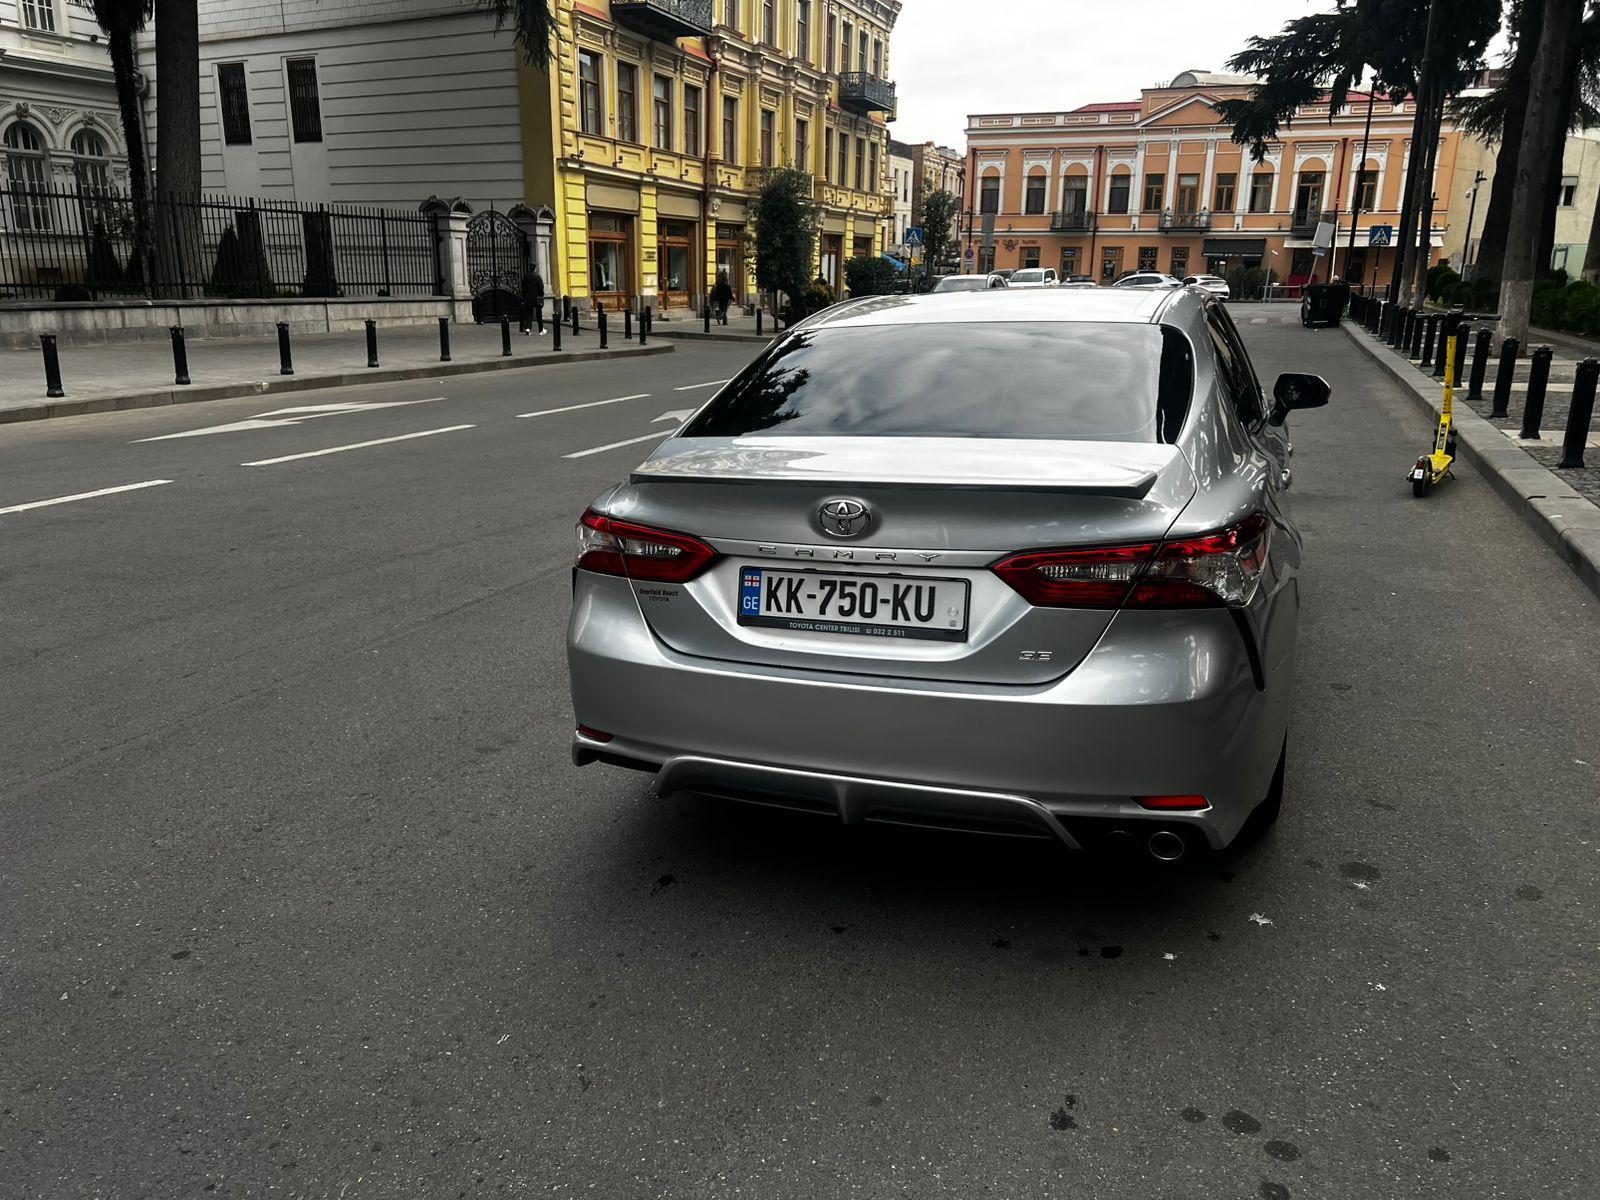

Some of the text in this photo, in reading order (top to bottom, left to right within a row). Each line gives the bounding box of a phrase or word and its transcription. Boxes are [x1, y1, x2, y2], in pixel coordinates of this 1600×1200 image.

[758, 545, 942, 562] CAMRY
[743, 596, 759, 610] GE
[766, 576, 936, 622] KK-750-KU
[789, 622, 813, 630] TOYOTA
[816, 624, 839, 632] CENTER
[840, 625, 860, 633] TBILISI
[873, 628, 885, 636] 032
[1018, 650, 1053, 661] SE
